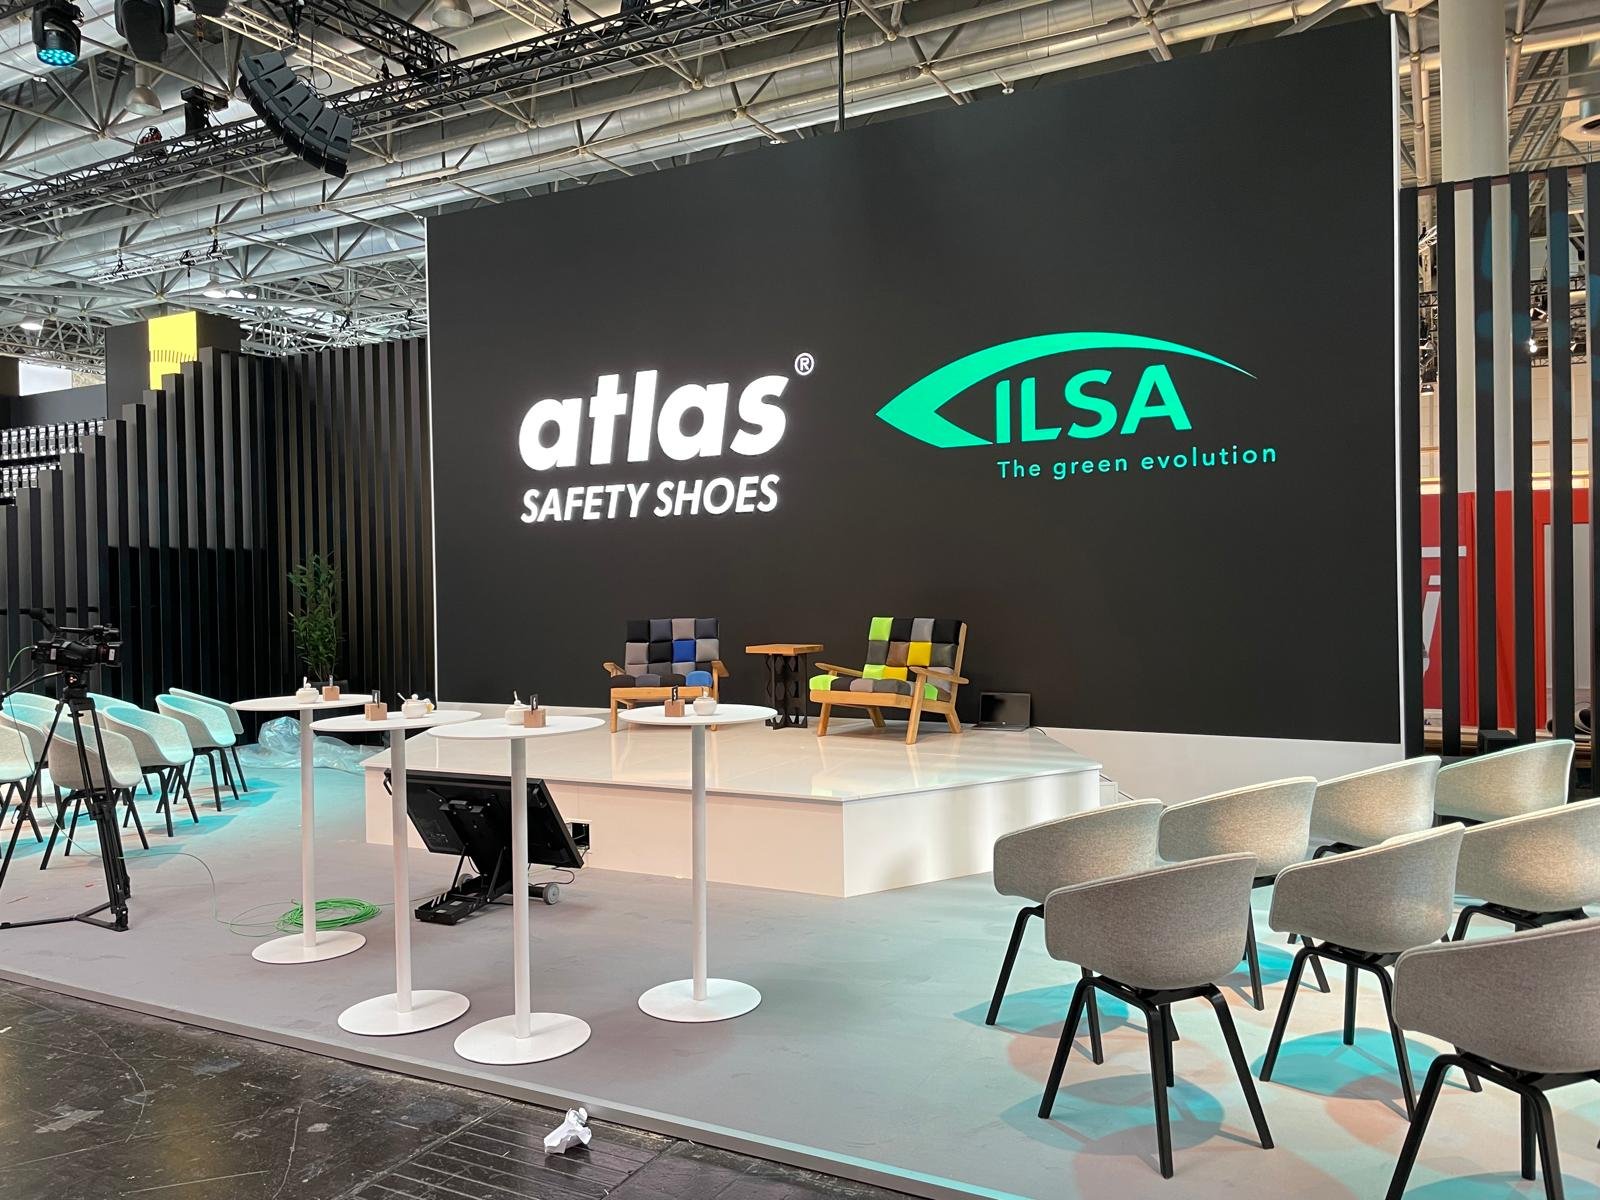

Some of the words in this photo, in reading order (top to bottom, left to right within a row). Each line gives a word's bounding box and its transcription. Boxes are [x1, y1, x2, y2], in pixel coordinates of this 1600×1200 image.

[519, 370, 790, 471] atlas
[995, 364, 1193, 444] ILSA
[997, 460, 1041, 479] The
[1053, 458, 1128, 480] green
[1141, 445, 1277, 470] evolution
[520, 482, 651, 524] SAFETY
[654, 474, 780, 518] SHOES
